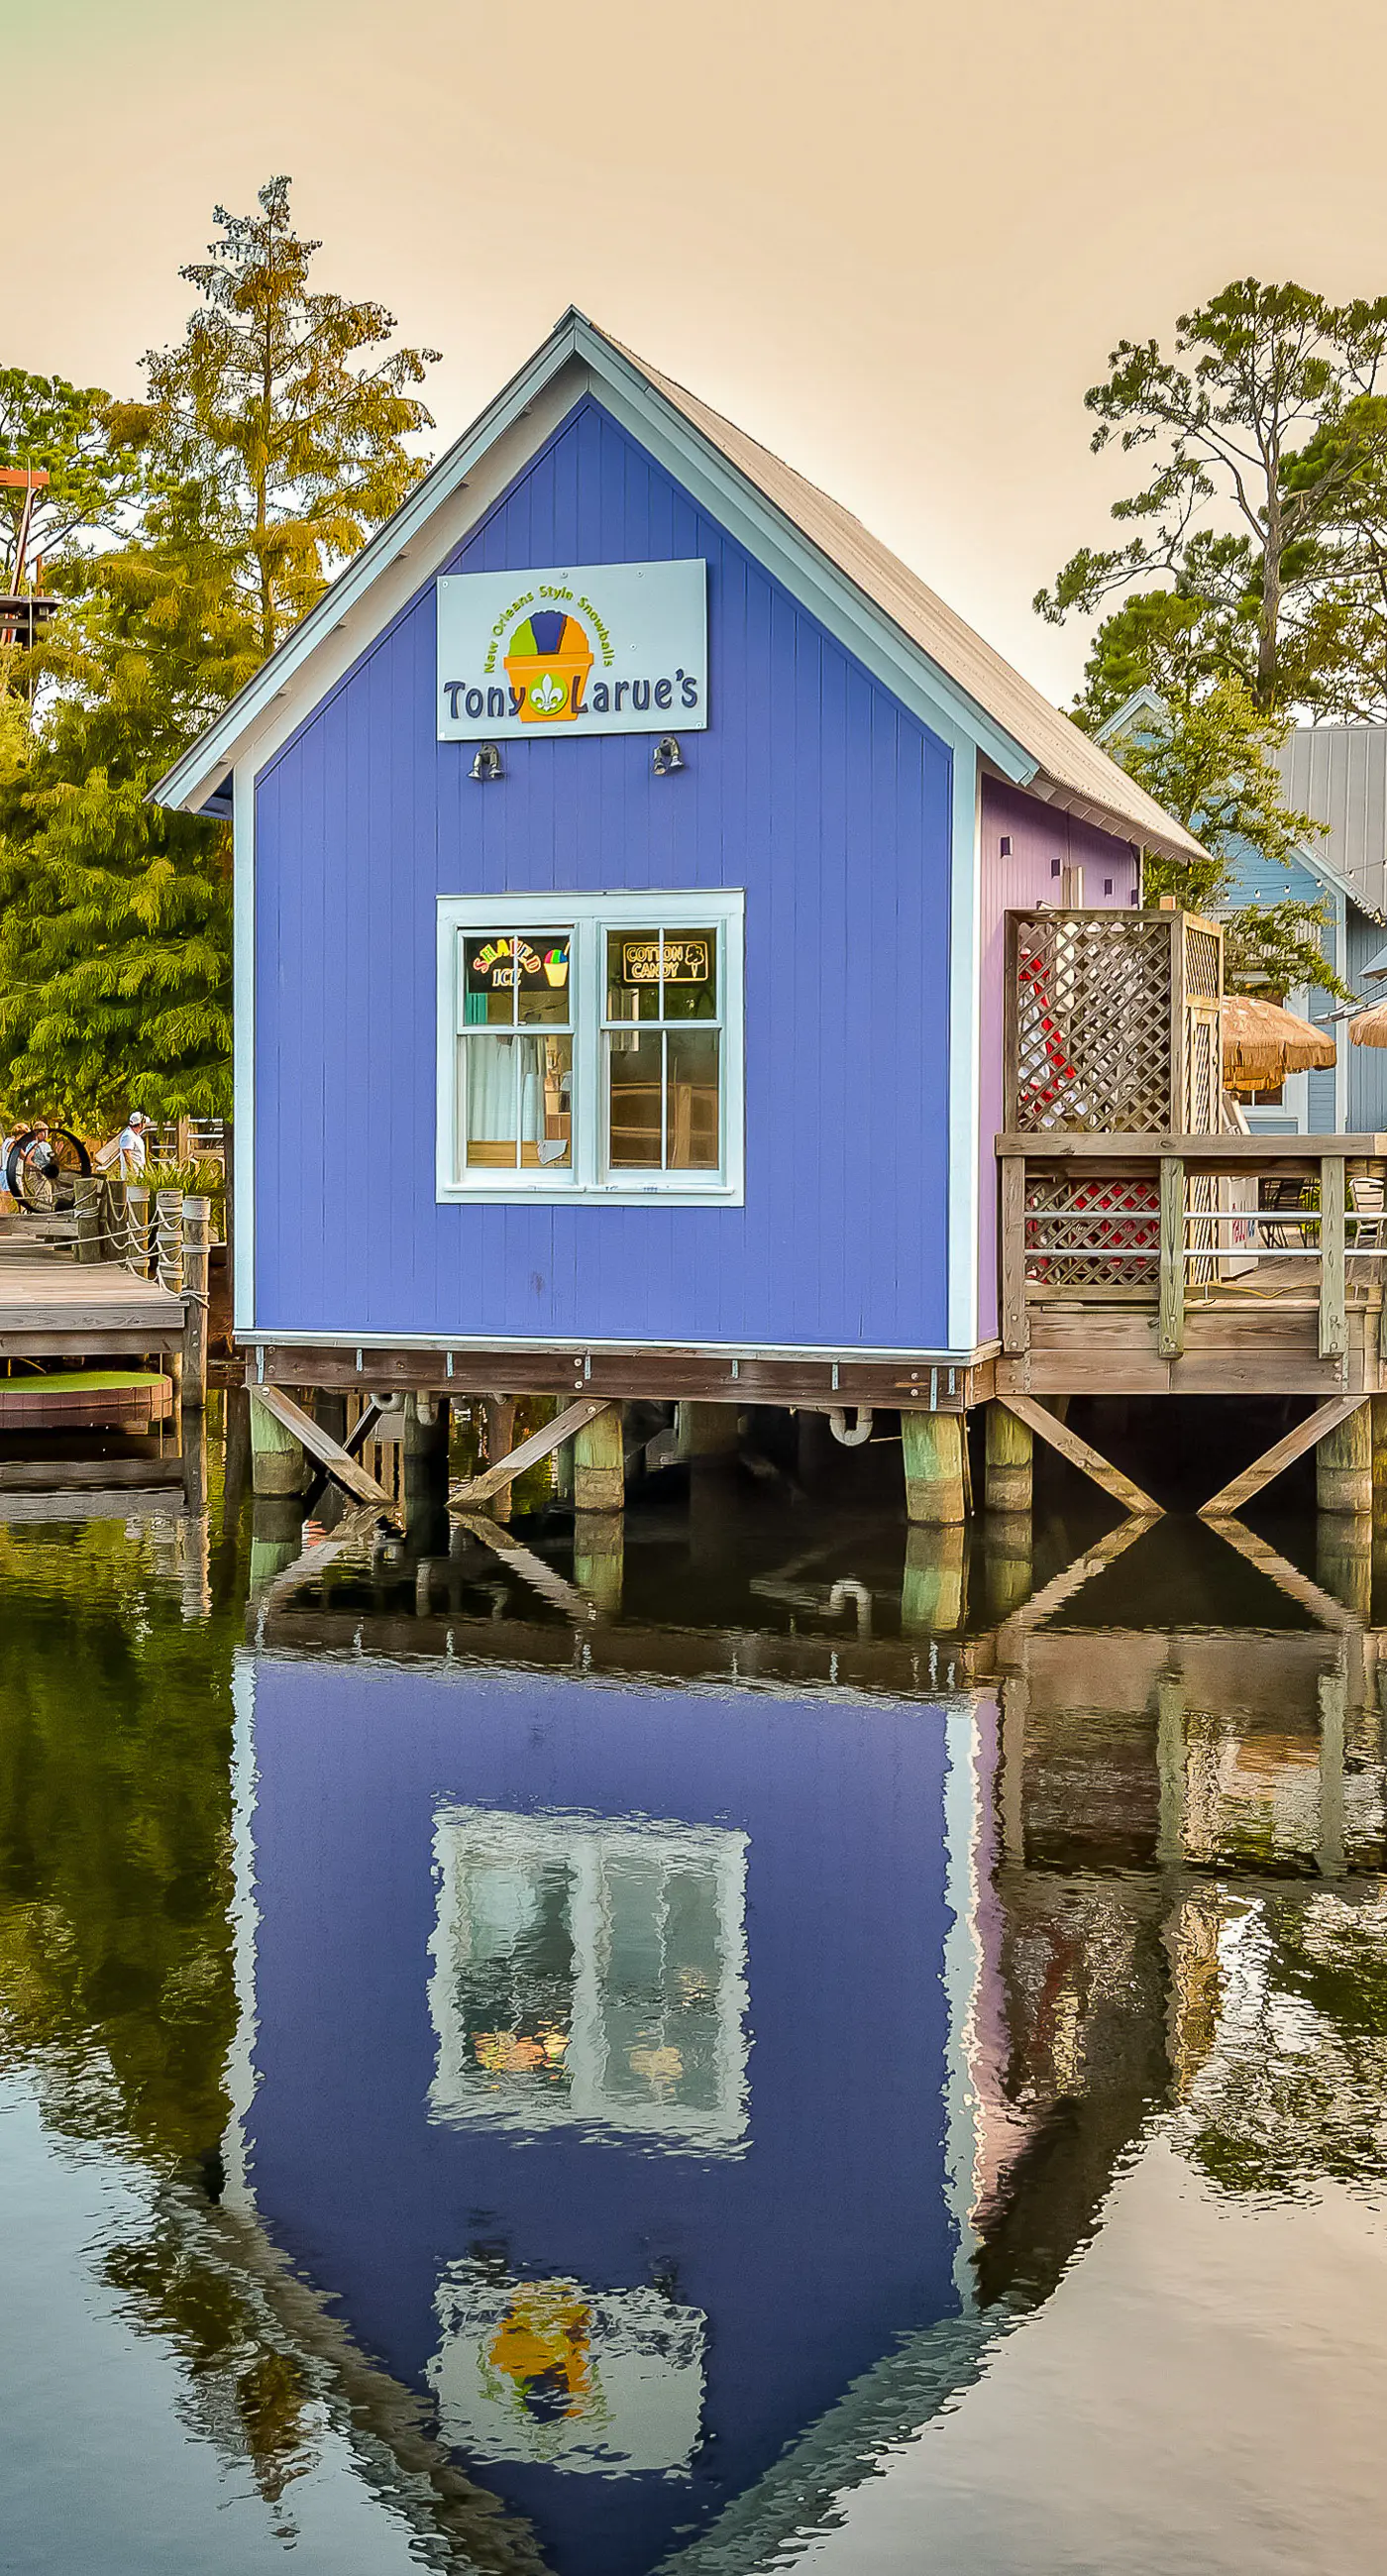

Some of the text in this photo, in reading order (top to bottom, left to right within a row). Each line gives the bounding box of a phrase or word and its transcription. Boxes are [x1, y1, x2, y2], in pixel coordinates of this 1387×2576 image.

[483, 586, 615, 674] New Orleans Style Snowballs
[444, 668, 698, 718] Tony Larue's
[474, 938, 541, 974] SHAVED
[626, 945, 684, 963] COTTON
[491, 968, 523, 987] ICE
[632, 962, 680, 978] CANDY
